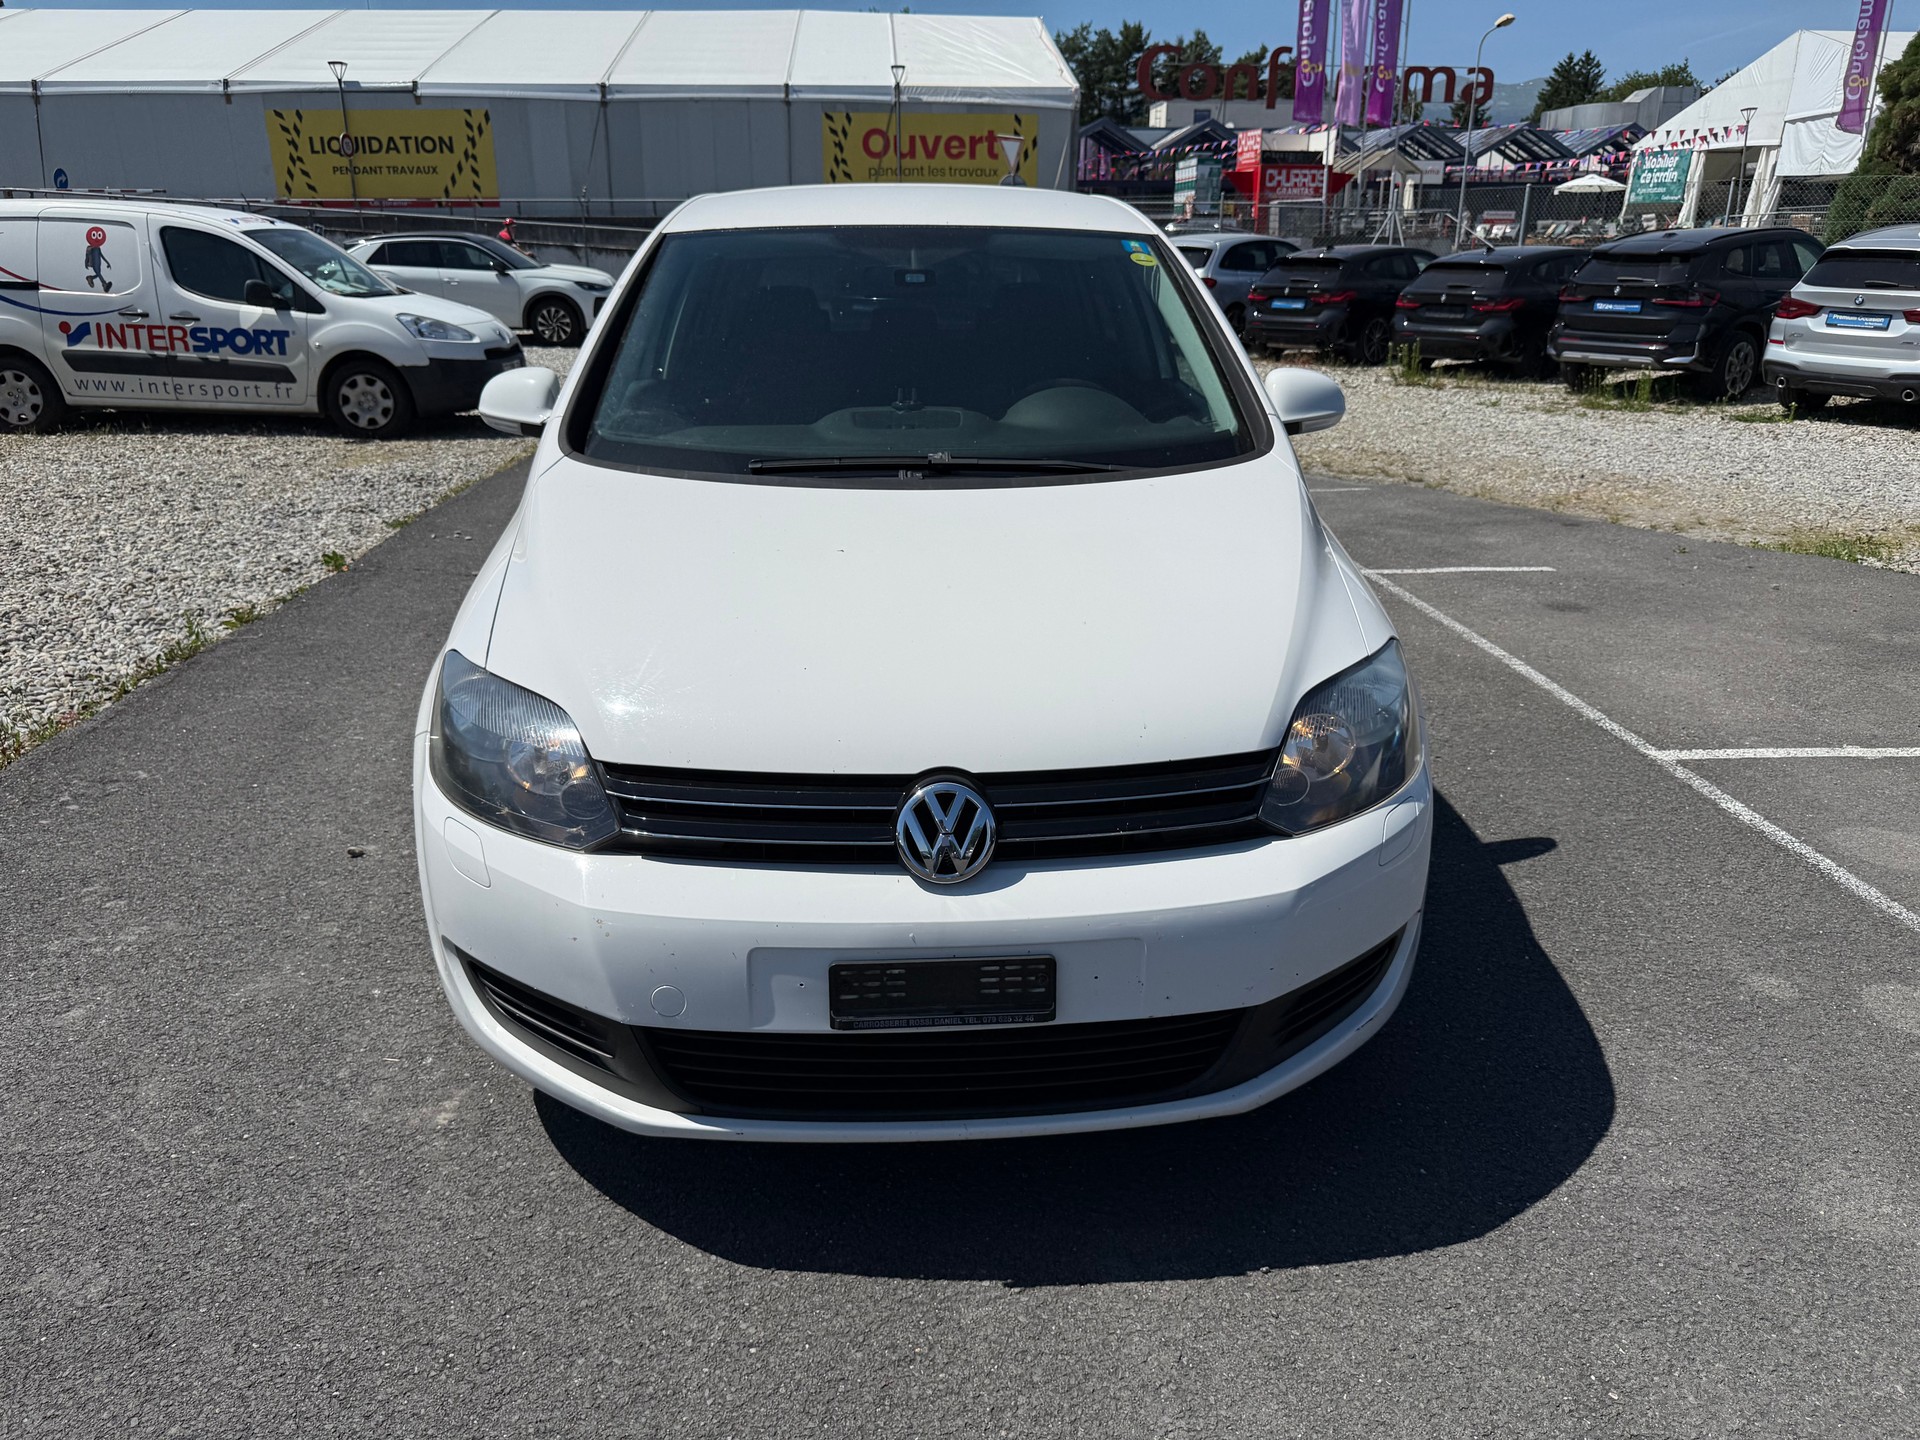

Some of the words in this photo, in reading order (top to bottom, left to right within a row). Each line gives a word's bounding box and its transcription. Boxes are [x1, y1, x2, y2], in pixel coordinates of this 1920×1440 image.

[1136, 45, 1495, 110] Confma
[862, 128, 999, 161] Ouvert
[332, 165, 384, 176] PENDANT
[386, 165, 438, 176] TRAVAUX
[927, 164, 947, 178] les
[949, 165, 999, 178] travaux
[96, 322, 290, 356] INTERSPORT
[74, 377, 294, 400] www.intersport.fr
[934, 1016, 963, 1025] DANIEL
